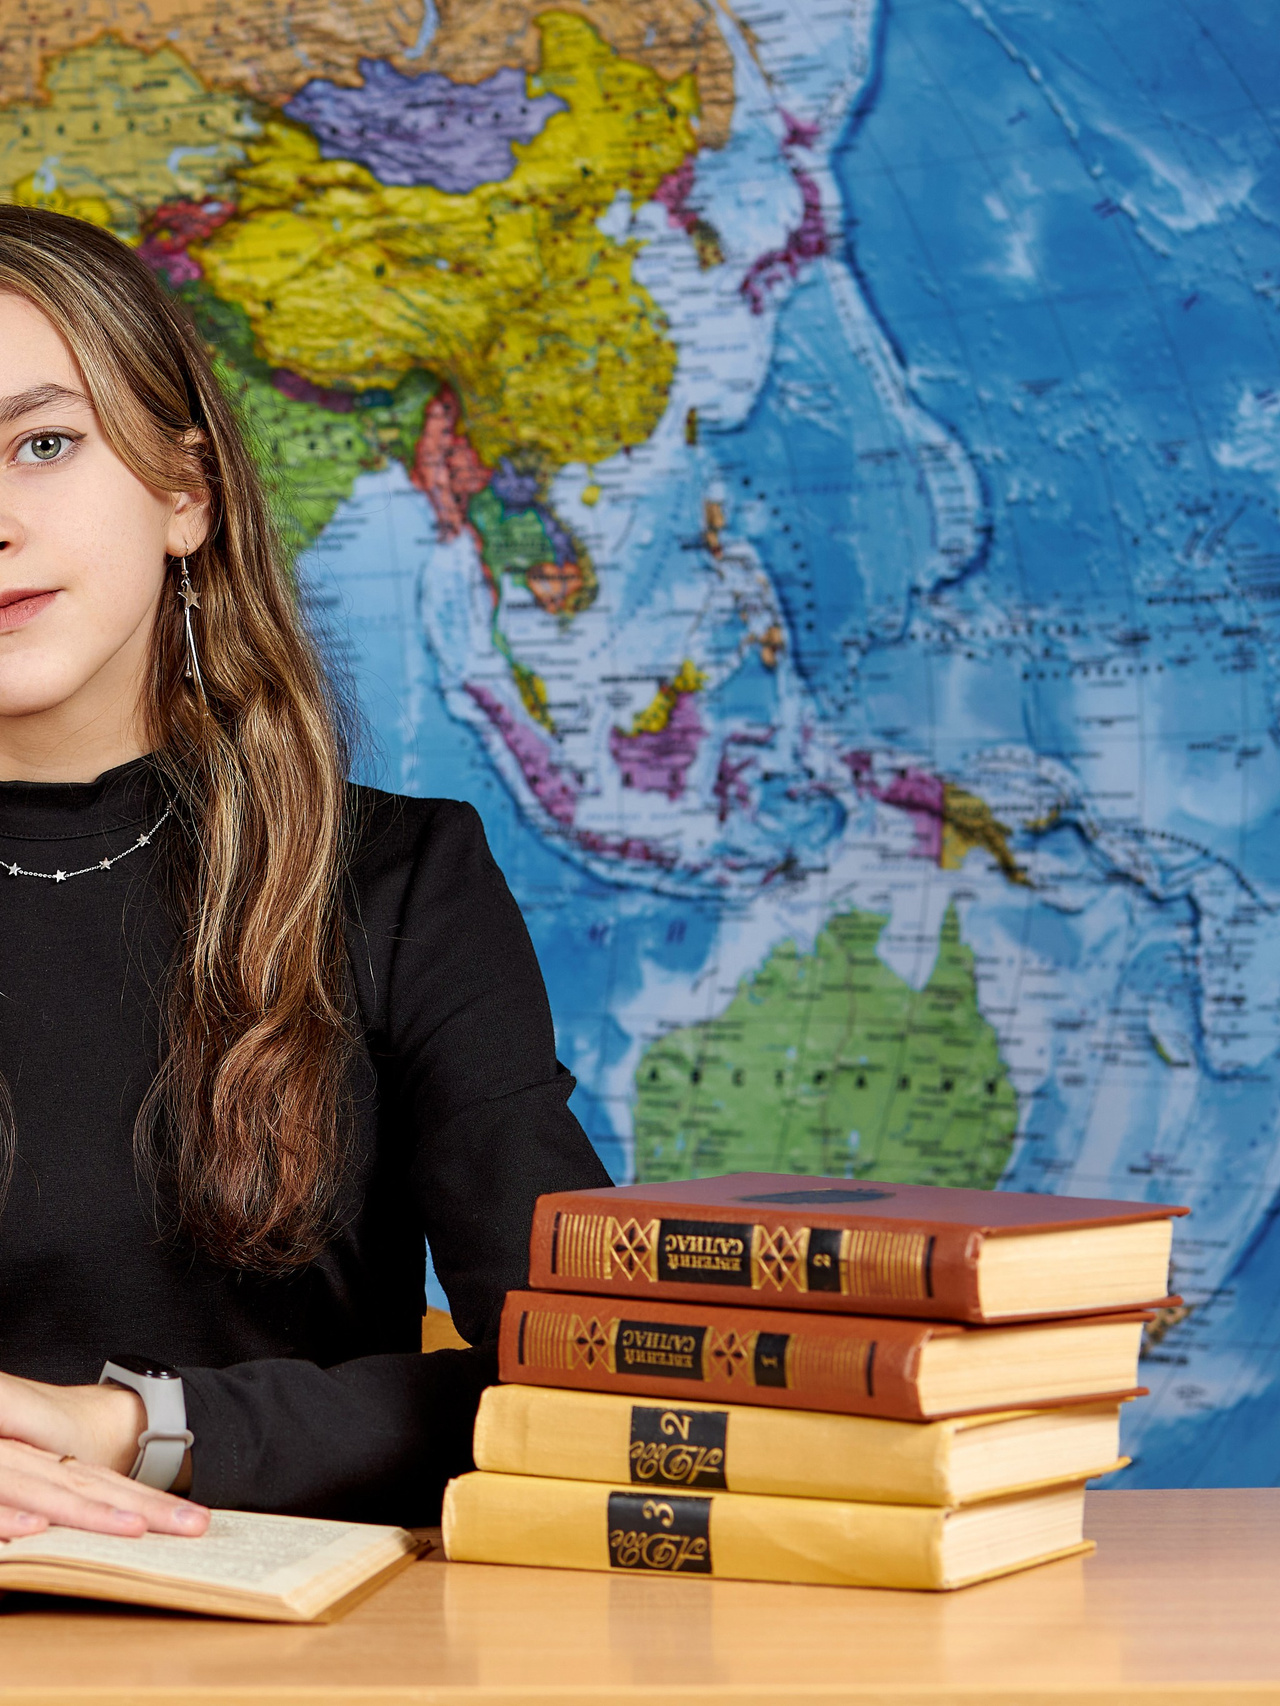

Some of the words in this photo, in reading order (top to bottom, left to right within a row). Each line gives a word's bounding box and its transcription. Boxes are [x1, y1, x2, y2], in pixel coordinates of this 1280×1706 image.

[665, 1234, 744, 1256] САЛИАС
[667, 1253, 742, 1271] ЕВГЕНИЙ
[812, 1253, 832, 1269] 2
[622, 1329, 696, 1353] САЛИАС
[624, 1348, 694, 1368] ЕВГЕНИЙ
[660, 1411, 693, 1441] 2
[642, 1499, 674, 1529] 3
